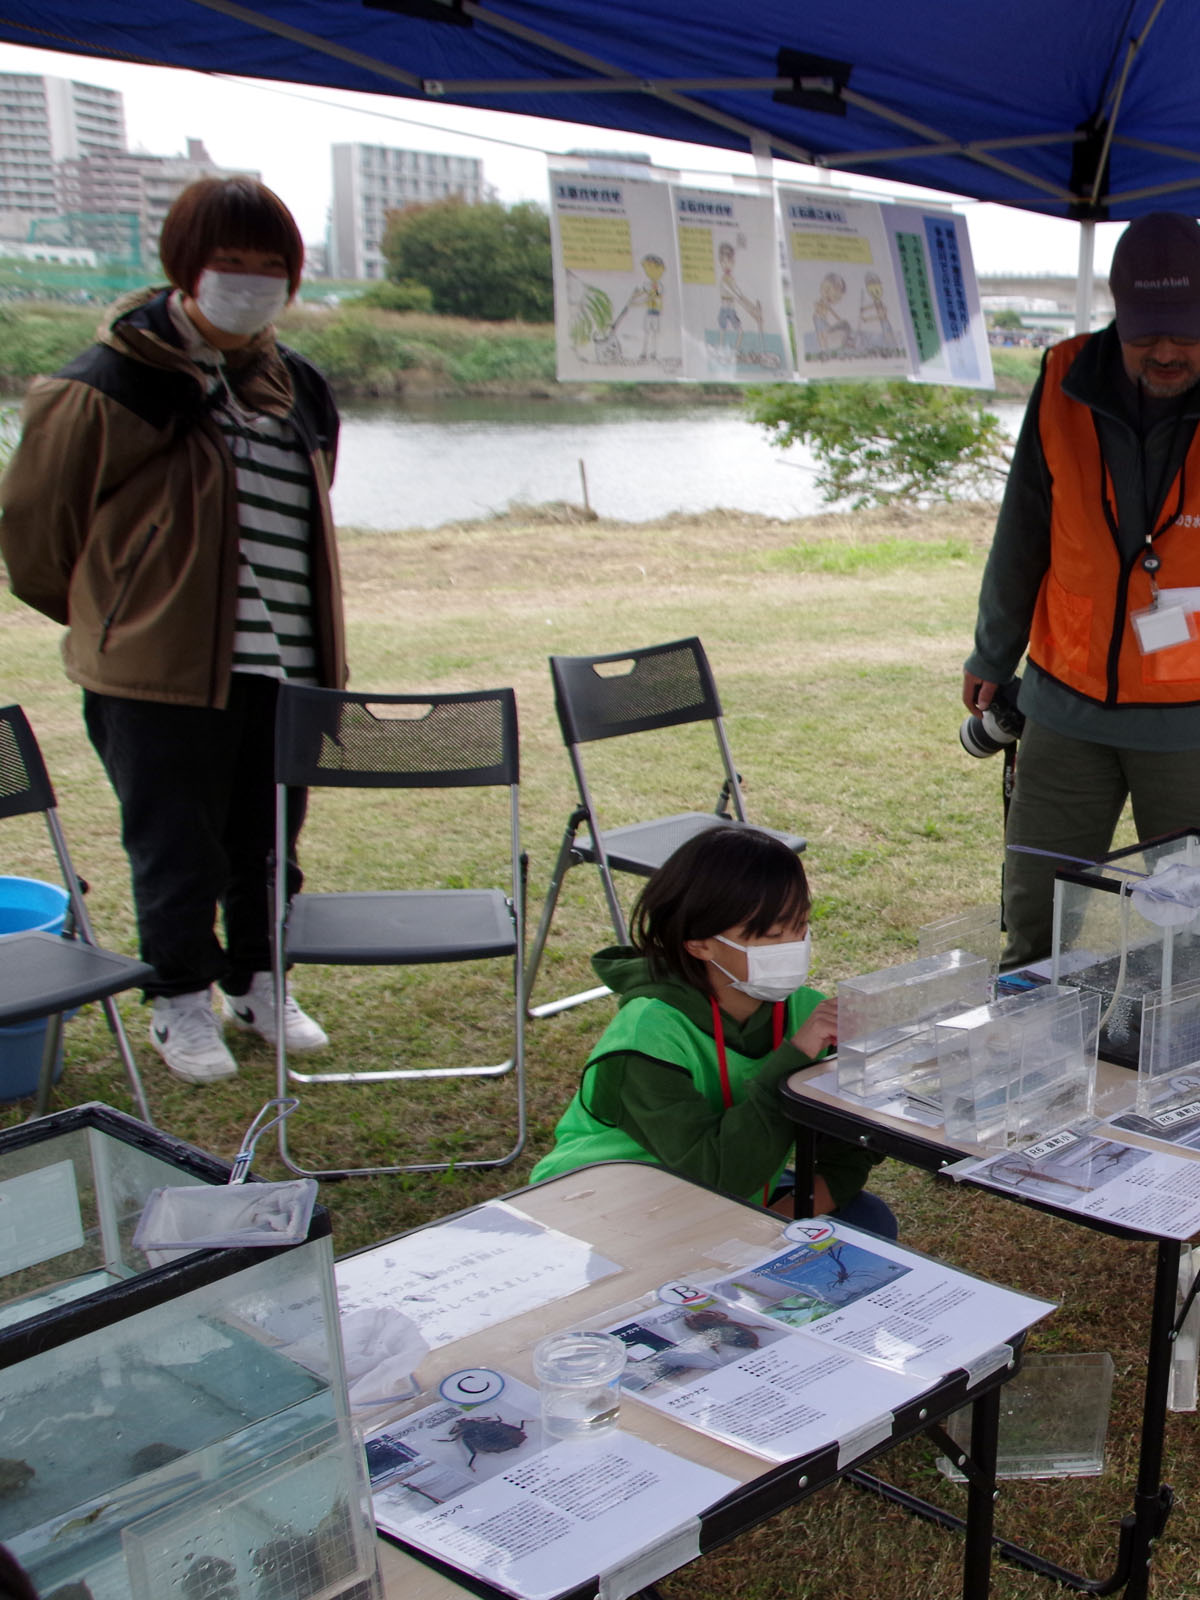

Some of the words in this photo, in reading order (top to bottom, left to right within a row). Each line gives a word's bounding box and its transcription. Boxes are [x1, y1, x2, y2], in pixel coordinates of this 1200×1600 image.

[1159, 1114, 1174, 1124] R6
[1028, 1146, 1045, 1156] R6
[796, 1226, 823, 1239] A
[667, 1285, 699, 1300] B
[457, 1375, 491, 1395] C
